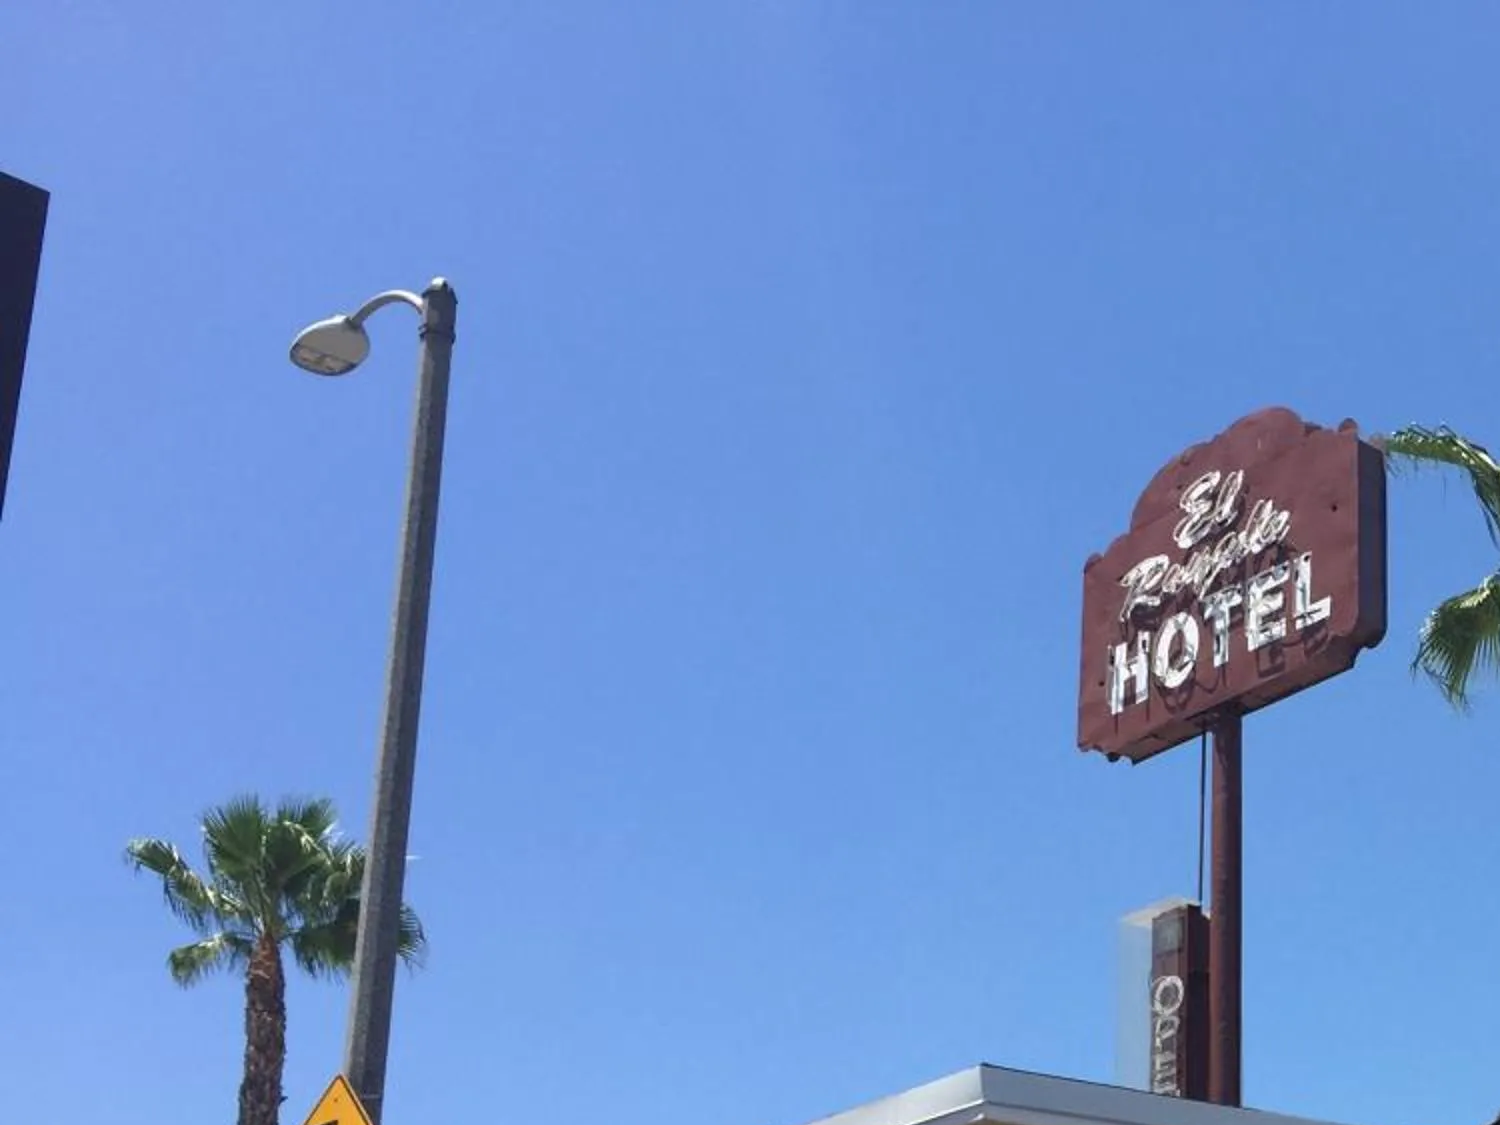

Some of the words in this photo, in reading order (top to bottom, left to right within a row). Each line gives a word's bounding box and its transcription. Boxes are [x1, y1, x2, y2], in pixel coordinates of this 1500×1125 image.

[1173, 469, 1244, 549] El
[1108, 551, 1331, 715] HOTEL
[1153, 975, 1184, 1097] OPE
